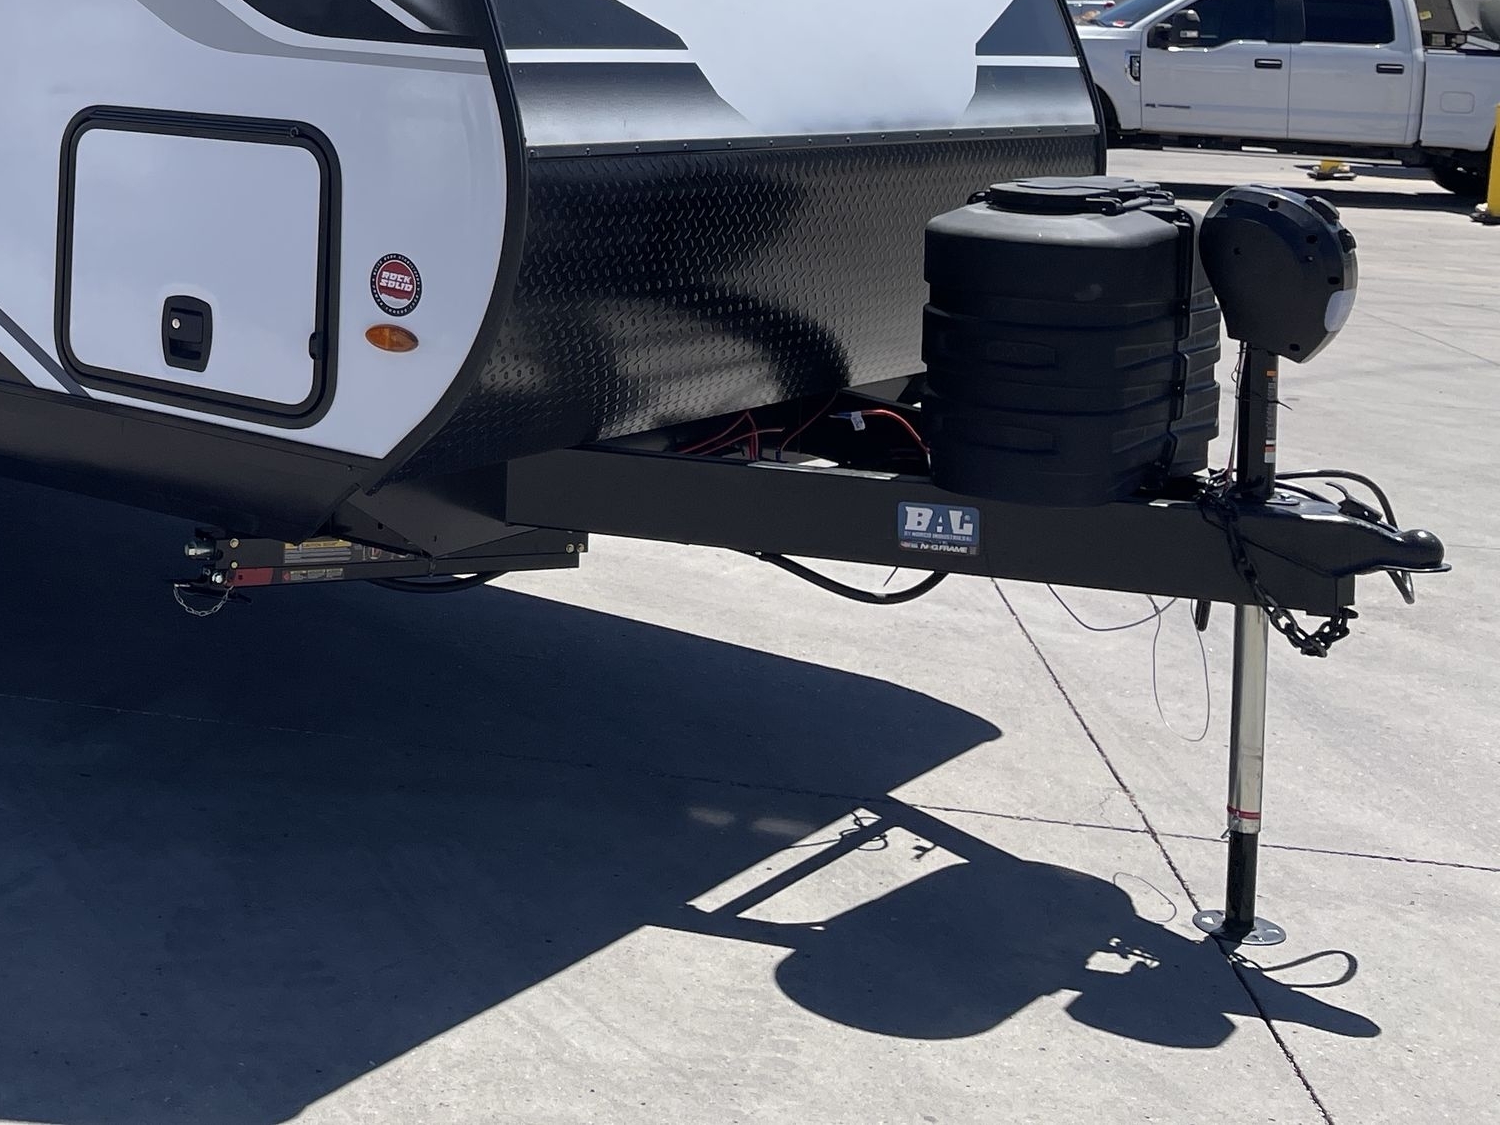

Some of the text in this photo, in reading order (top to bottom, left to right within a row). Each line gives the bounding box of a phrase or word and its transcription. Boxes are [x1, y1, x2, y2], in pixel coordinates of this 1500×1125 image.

[381, 271, 412, 284] ROCK
[379, 278, 413, 292] SOLID
[904, 506, 973, 536] BAL
